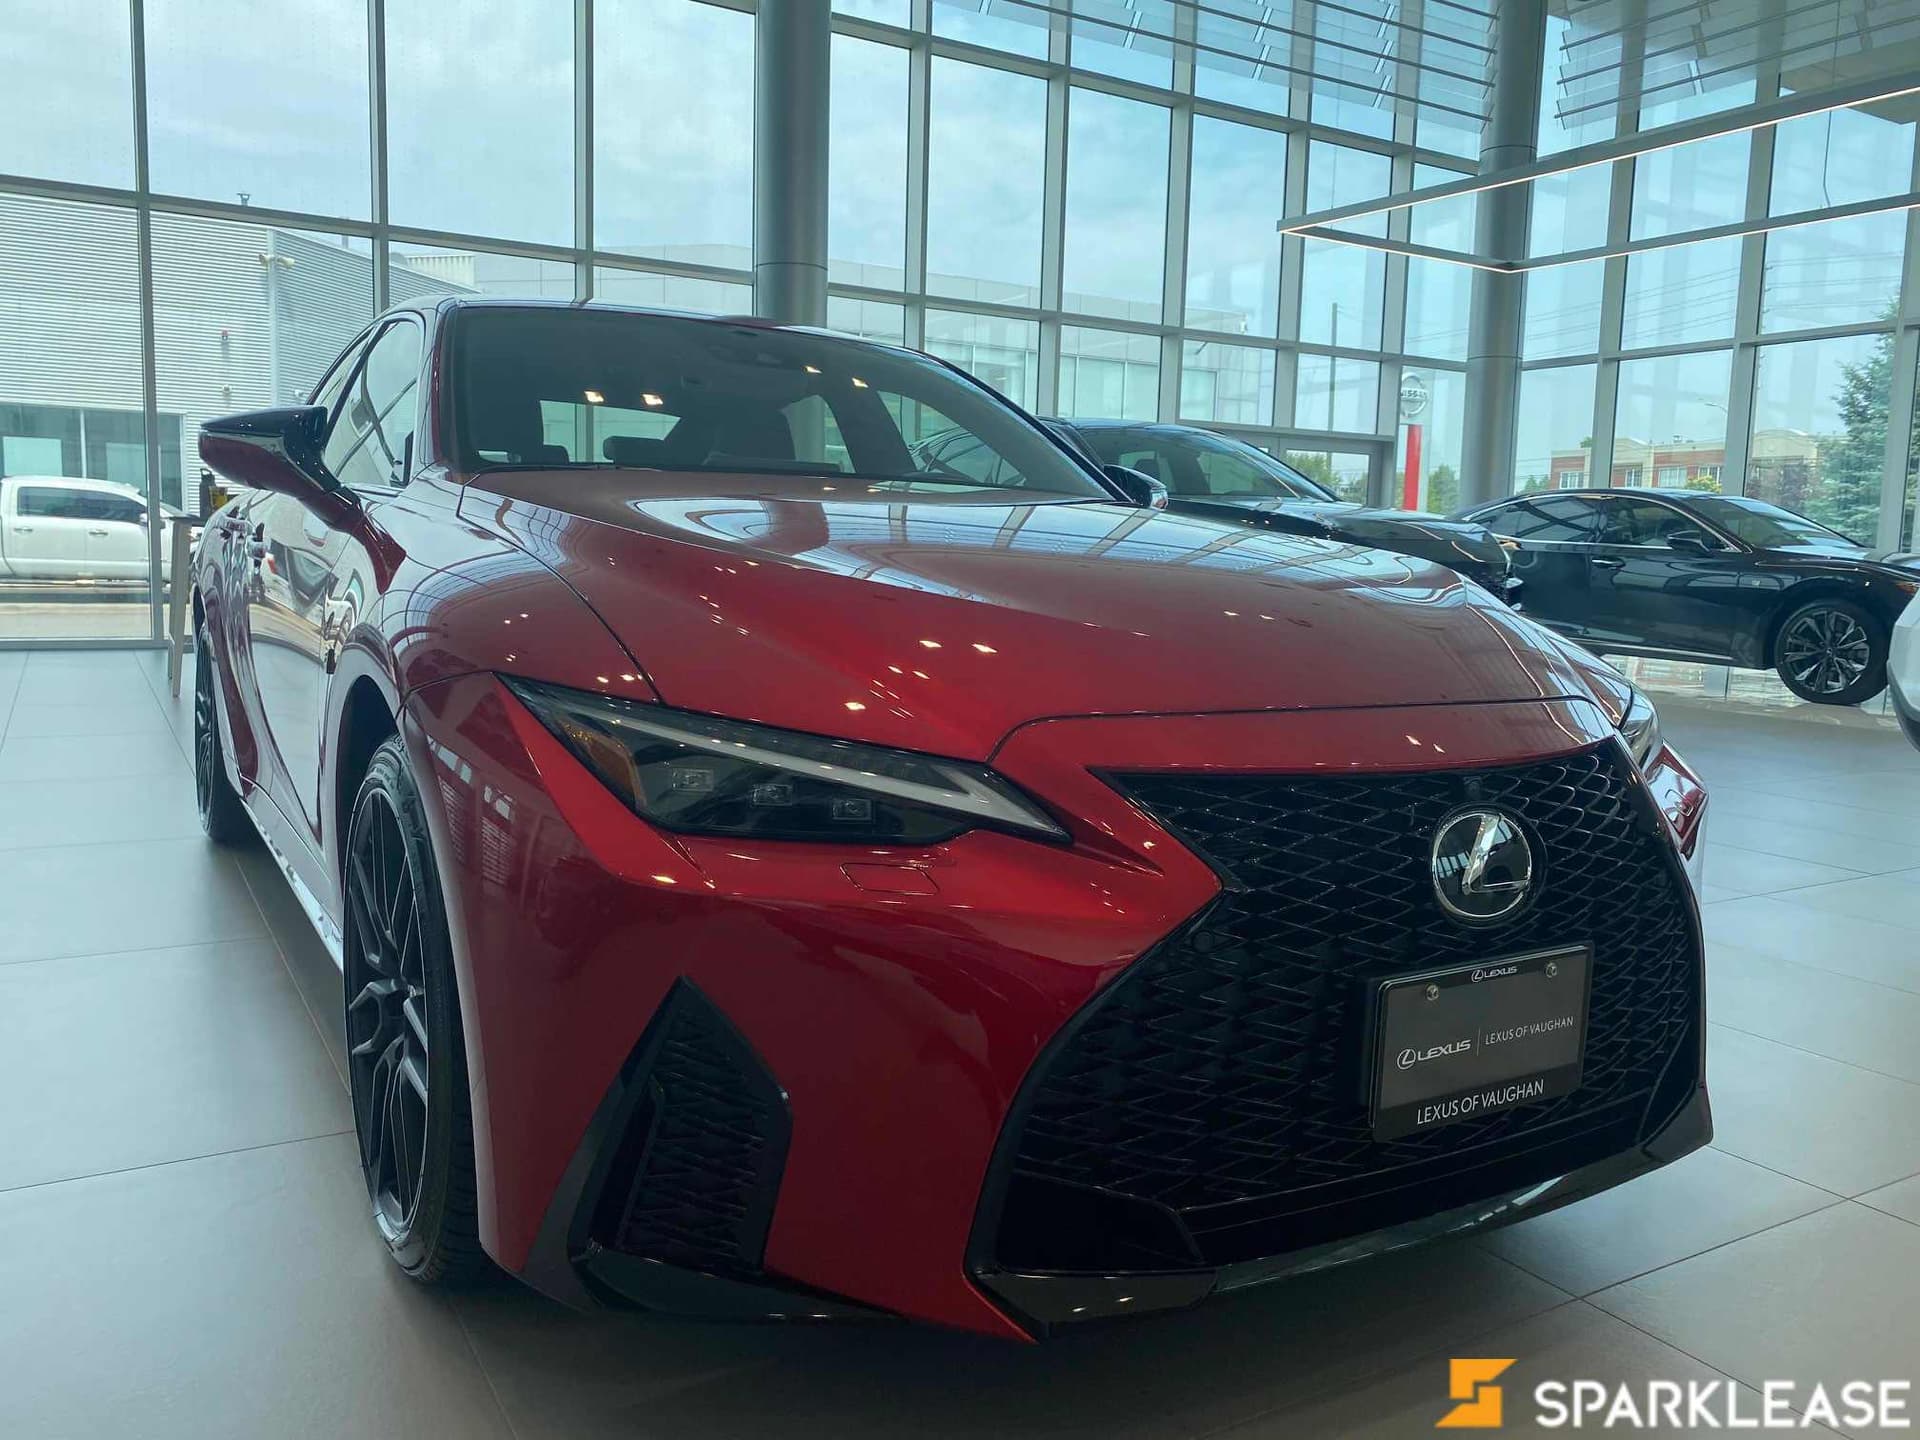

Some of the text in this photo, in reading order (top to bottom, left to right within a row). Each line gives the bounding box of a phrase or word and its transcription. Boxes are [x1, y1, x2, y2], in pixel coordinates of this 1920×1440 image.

[1484, 966, 1517, 977] LEXUS
[1485, 1016, 1574, 1045] LEXUS OF VAUGHAN
[1417, 1039, 1472, 1061] LEXUS
[1417, 1079, 1545, 1125] LEXUS OF VAUGHAN
